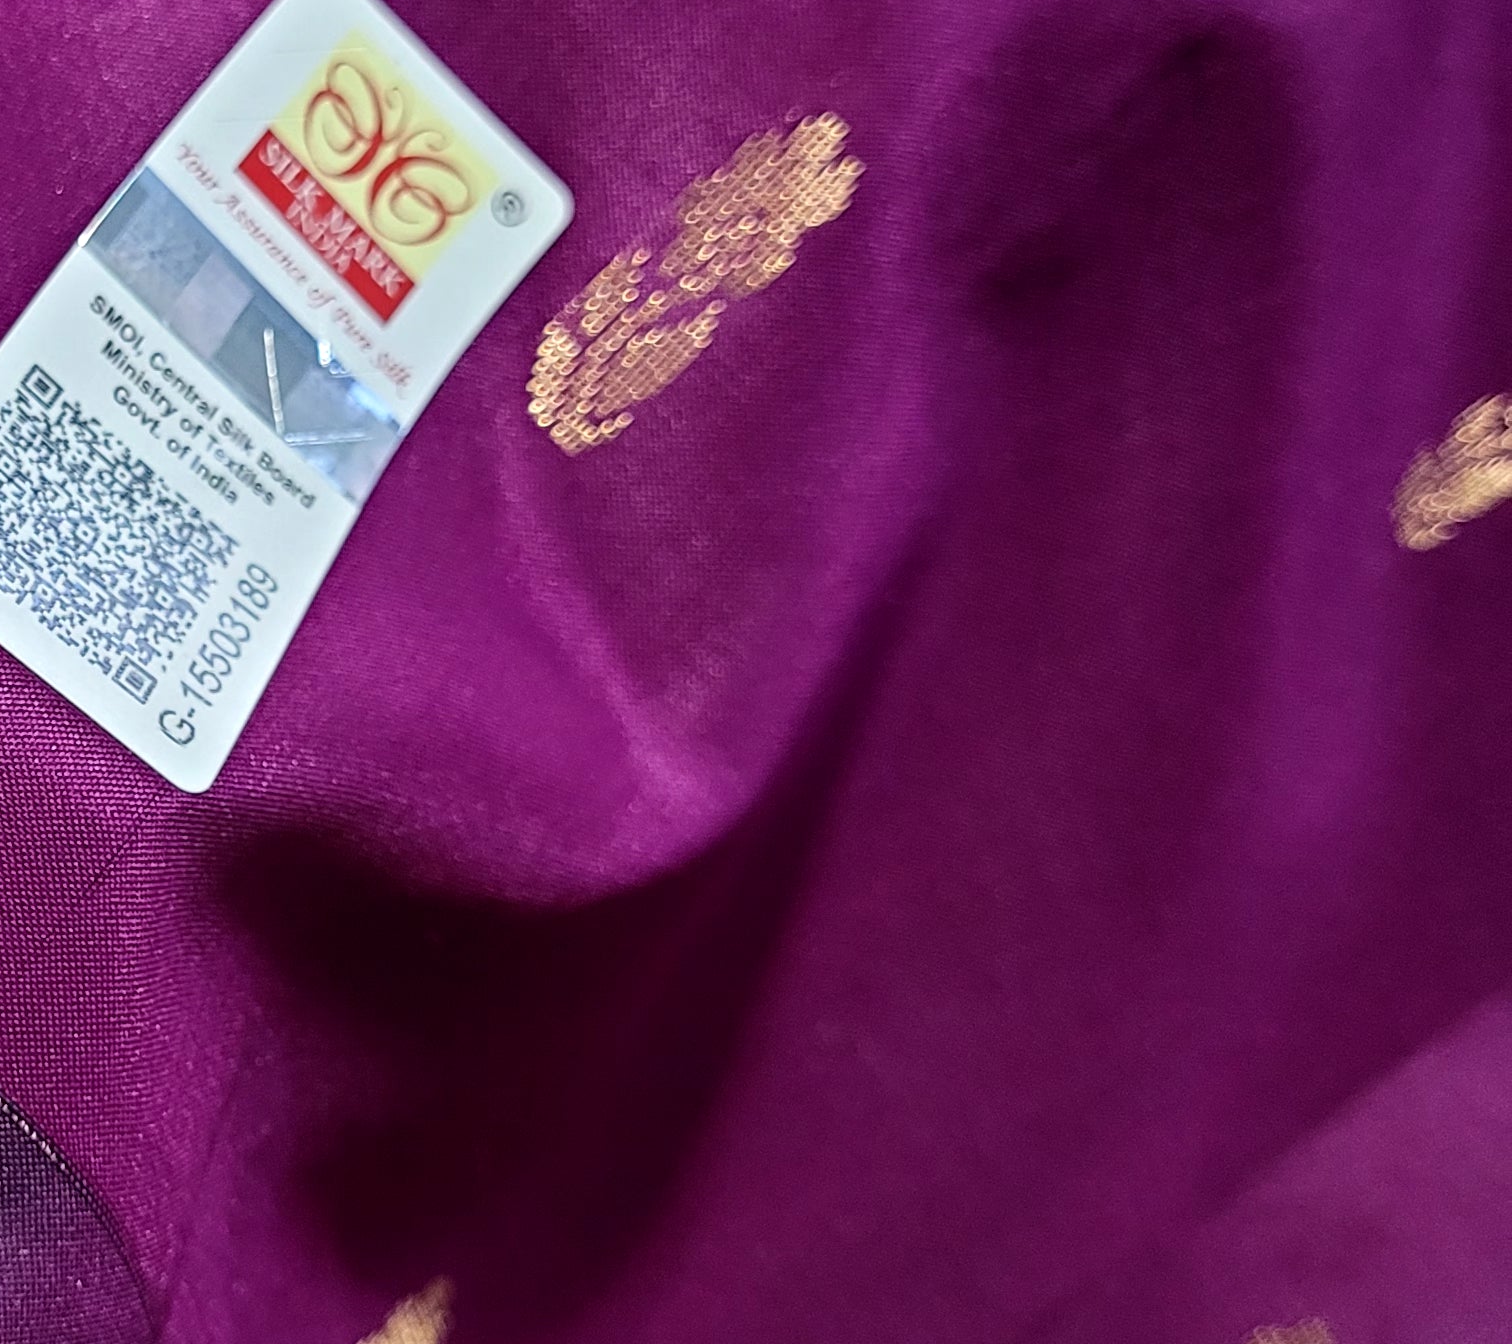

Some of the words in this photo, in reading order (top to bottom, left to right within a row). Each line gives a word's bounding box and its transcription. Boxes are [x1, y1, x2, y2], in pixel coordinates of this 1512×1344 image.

[178, 143, 222, 192] Your
[214, 195, 307, 285] Assurance
[307, 287, 337, 309] of
[258, 137, 323, 218] SILK
[328, 205, 403, 299] MARK
[286, 198, 353, 274] INDIA
[101, 340, 178, 418] Ministry
[179, 417, 205, 440] of
[206, 435, 275, 505] Textiles
[112, 385, 162, 440] Govt.
[166, 438, 192, 460] of
[190, 454, 239, 504] India
[149, 352, 219, 421] Central
[217, 417, 256, 452] Silk
[256, 451, 316, 510] Board
[158, 563, 278, 746] G-15503189
